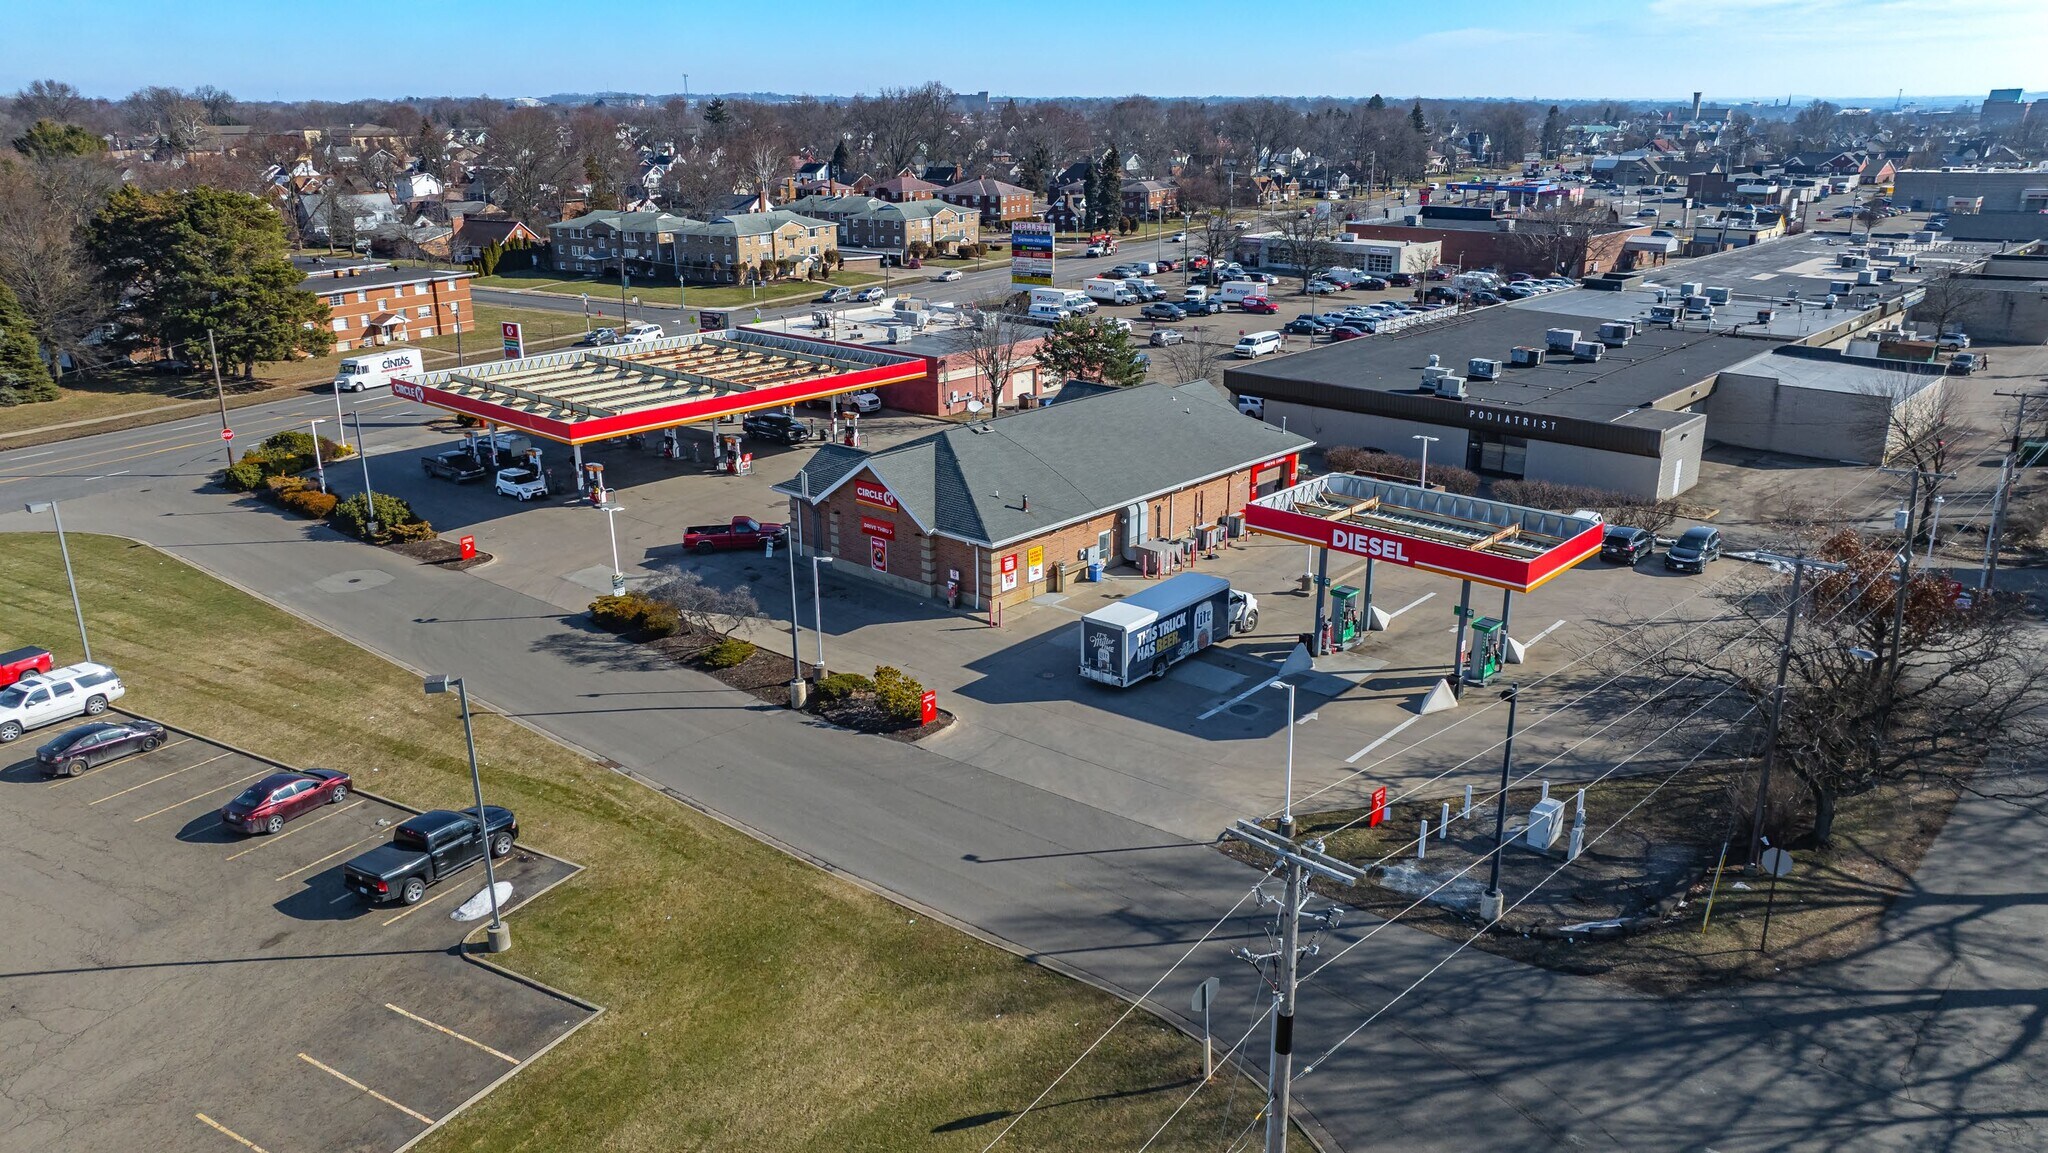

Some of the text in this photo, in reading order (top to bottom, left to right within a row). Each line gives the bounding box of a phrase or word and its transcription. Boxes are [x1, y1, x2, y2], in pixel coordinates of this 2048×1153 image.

[1093, 285, 1108, 294] Budget
[1233, 288, 1250, 296] Budget
[1042, 295, 1059, 304] Budget
[382, 356, 410, 369] CINTAS
[394, 383, 425, 402] CIRCLE K
[1469, 409, 1557, 431] PODIATRIST
[857, 487, 894, 506] CIRCLE K
[863, 522, 889, 534] DRIVE THRU
[1332, 529, 1409, 562] DIESEL
[1136, 625, 1158, 648] THIS
[1158, 612, 1187, 637] TRUCK
[1136, 641, 1156, 663] HAS
[1156, 630, 1181, 653] BEER.
